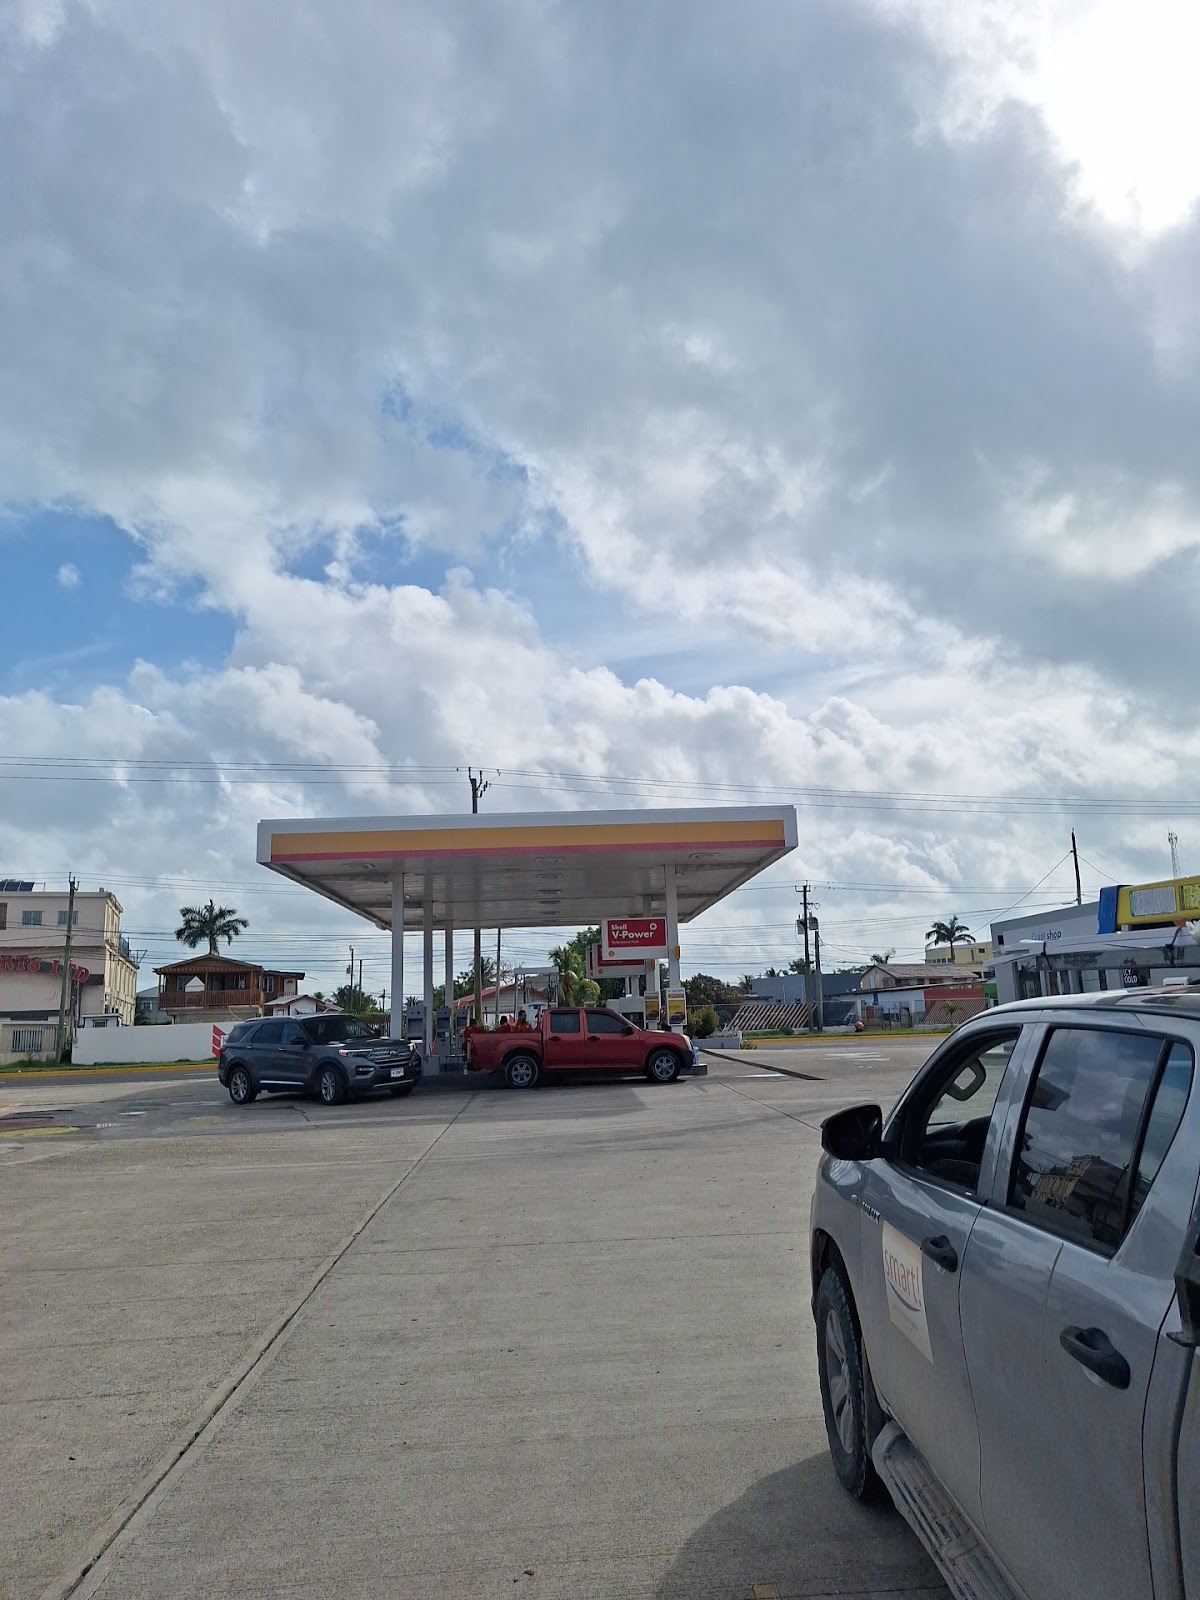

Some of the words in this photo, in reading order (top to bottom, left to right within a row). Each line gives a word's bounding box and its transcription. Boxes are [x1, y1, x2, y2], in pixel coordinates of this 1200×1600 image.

[611, 931, 654, 939] V-Power
[1046, 929, 1062, 940] shop
[884, 1249, 922, 1307] smart!
